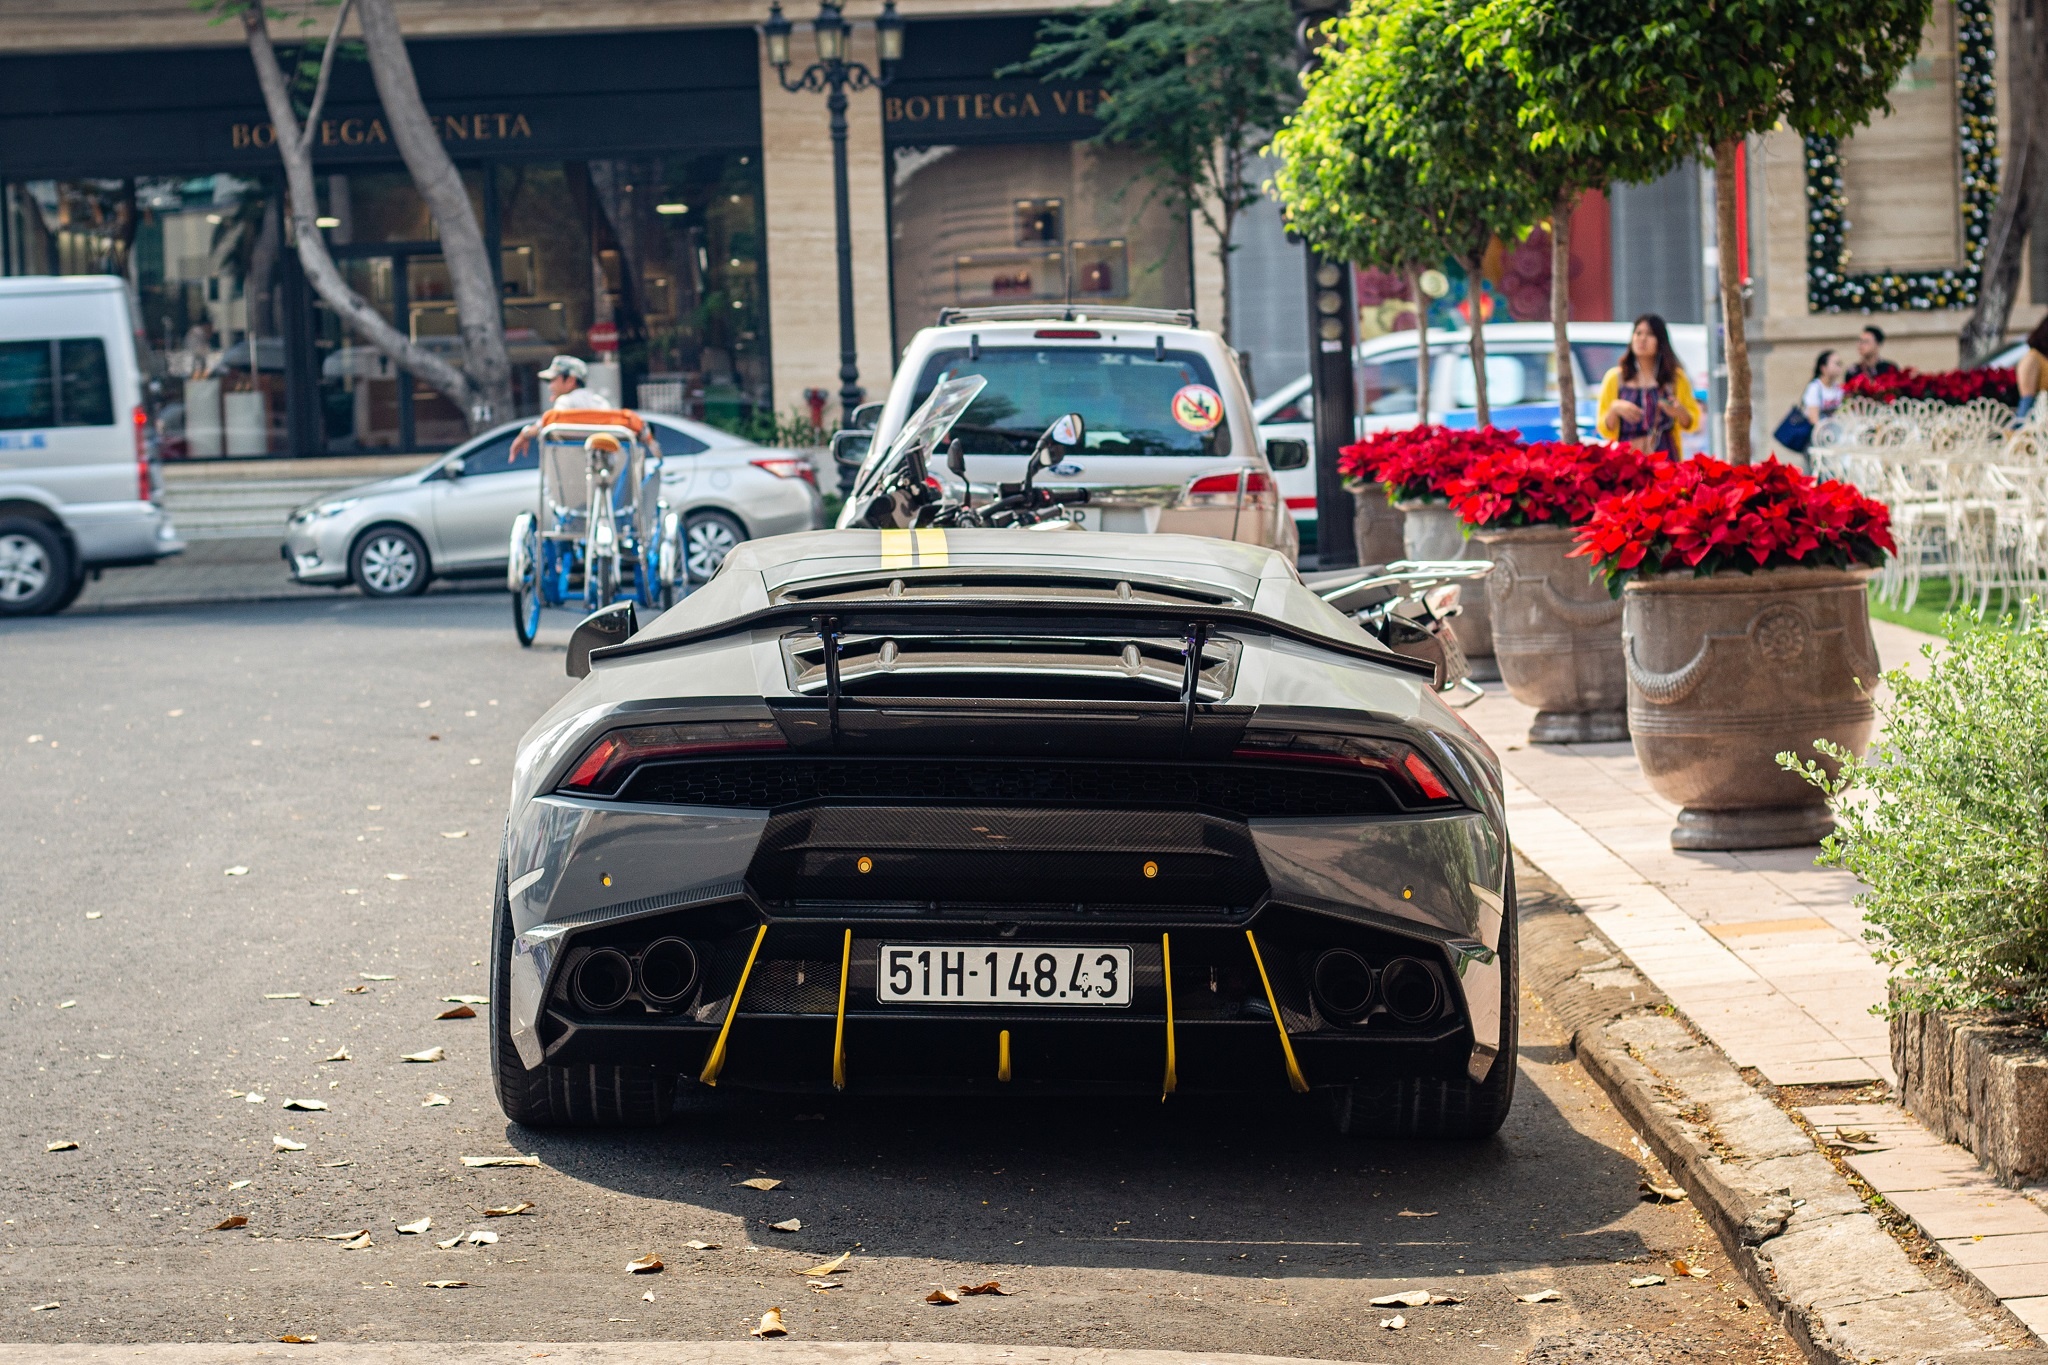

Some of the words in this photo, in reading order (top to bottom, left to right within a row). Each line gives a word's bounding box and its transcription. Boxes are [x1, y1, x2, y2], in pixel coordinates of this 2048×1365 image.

[886, 92, 1040, 122] BOTTEGA
[232, 118, 388, 148] BOEGA
[889, 950, 1119, 999] 51H-148.43
